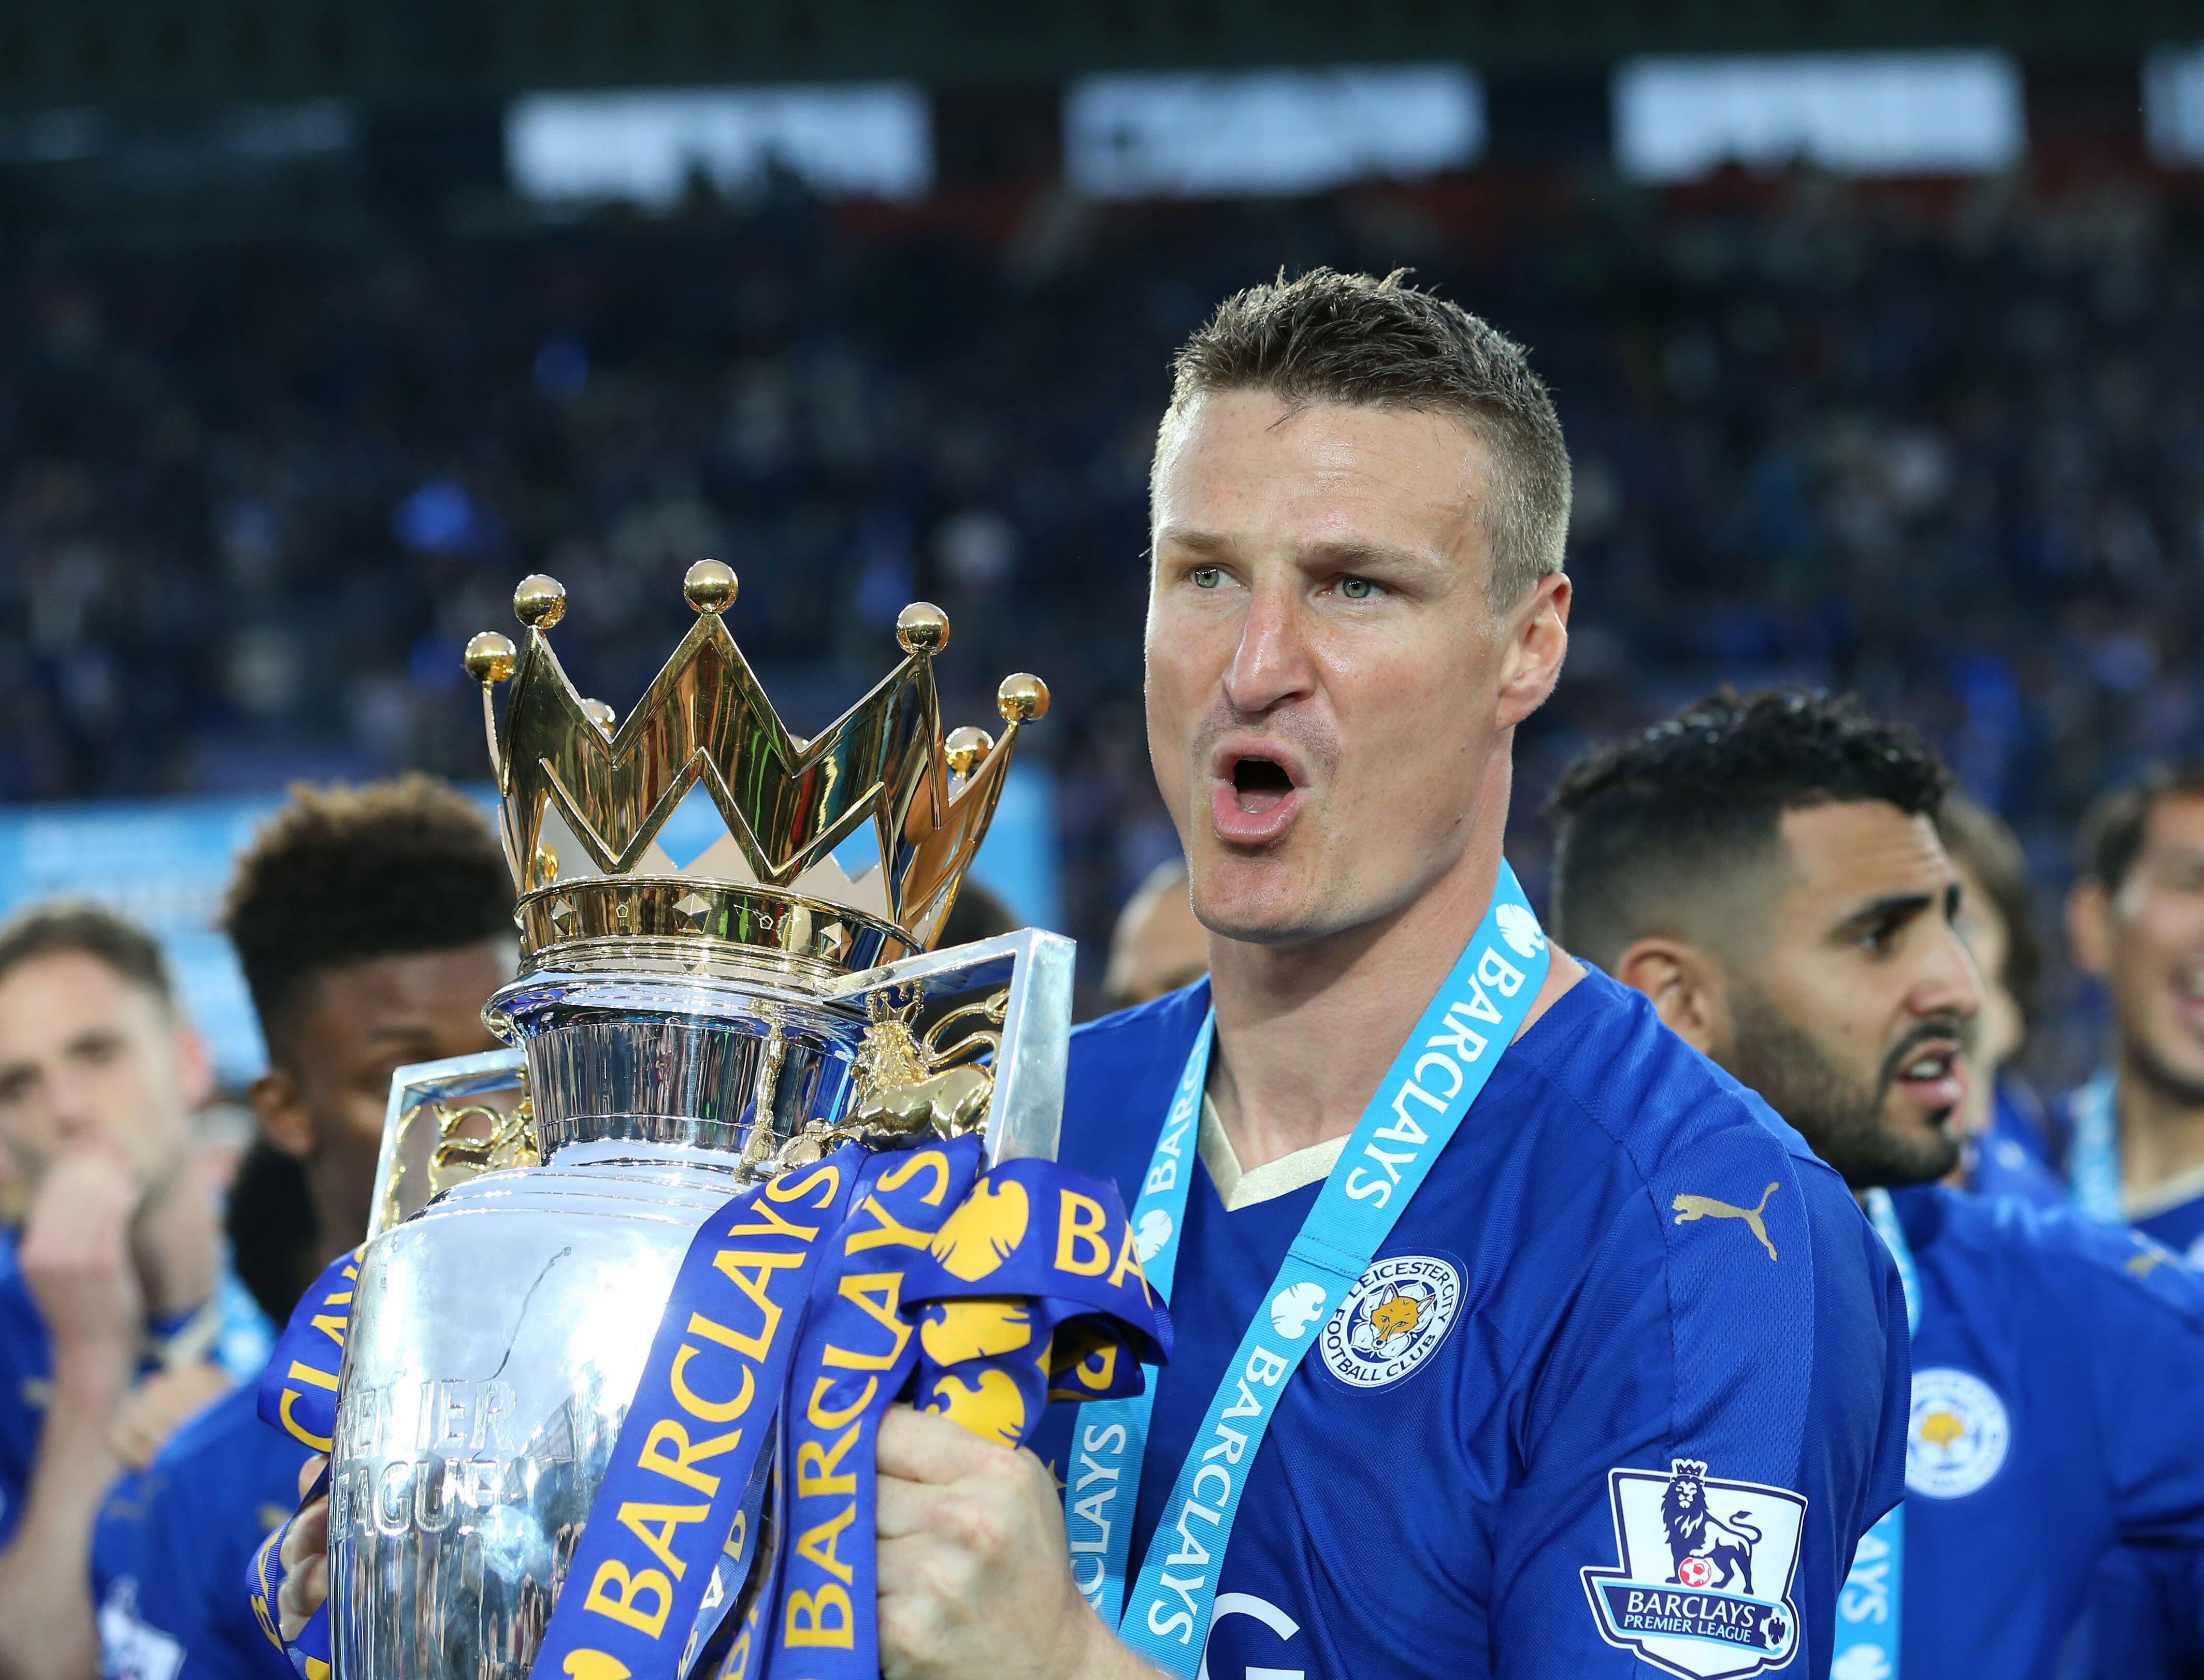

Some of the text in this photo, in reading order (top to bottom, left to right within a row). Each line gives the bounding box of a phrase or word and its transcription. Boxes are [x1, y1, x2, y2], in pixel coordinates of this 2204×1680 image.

[1344, 944, 1527, 1210] BARCLAYS
[1326, 1308, 1436, 1381] FOOTBALL CLUB
[1348, 1262, 1454, 1323] LEICESTER CITY
[583, 1165, 840, 1641] BARCLAYS
[783, 1150, 950, 1649] BARCLAYS
[1146, 1344, 1291, 1646] BARCLAYS
[1623, 1614, 1752, 1644] PREMIER LEAGUE
[1626, 1590, 1756, 1628] BARCLAYS
